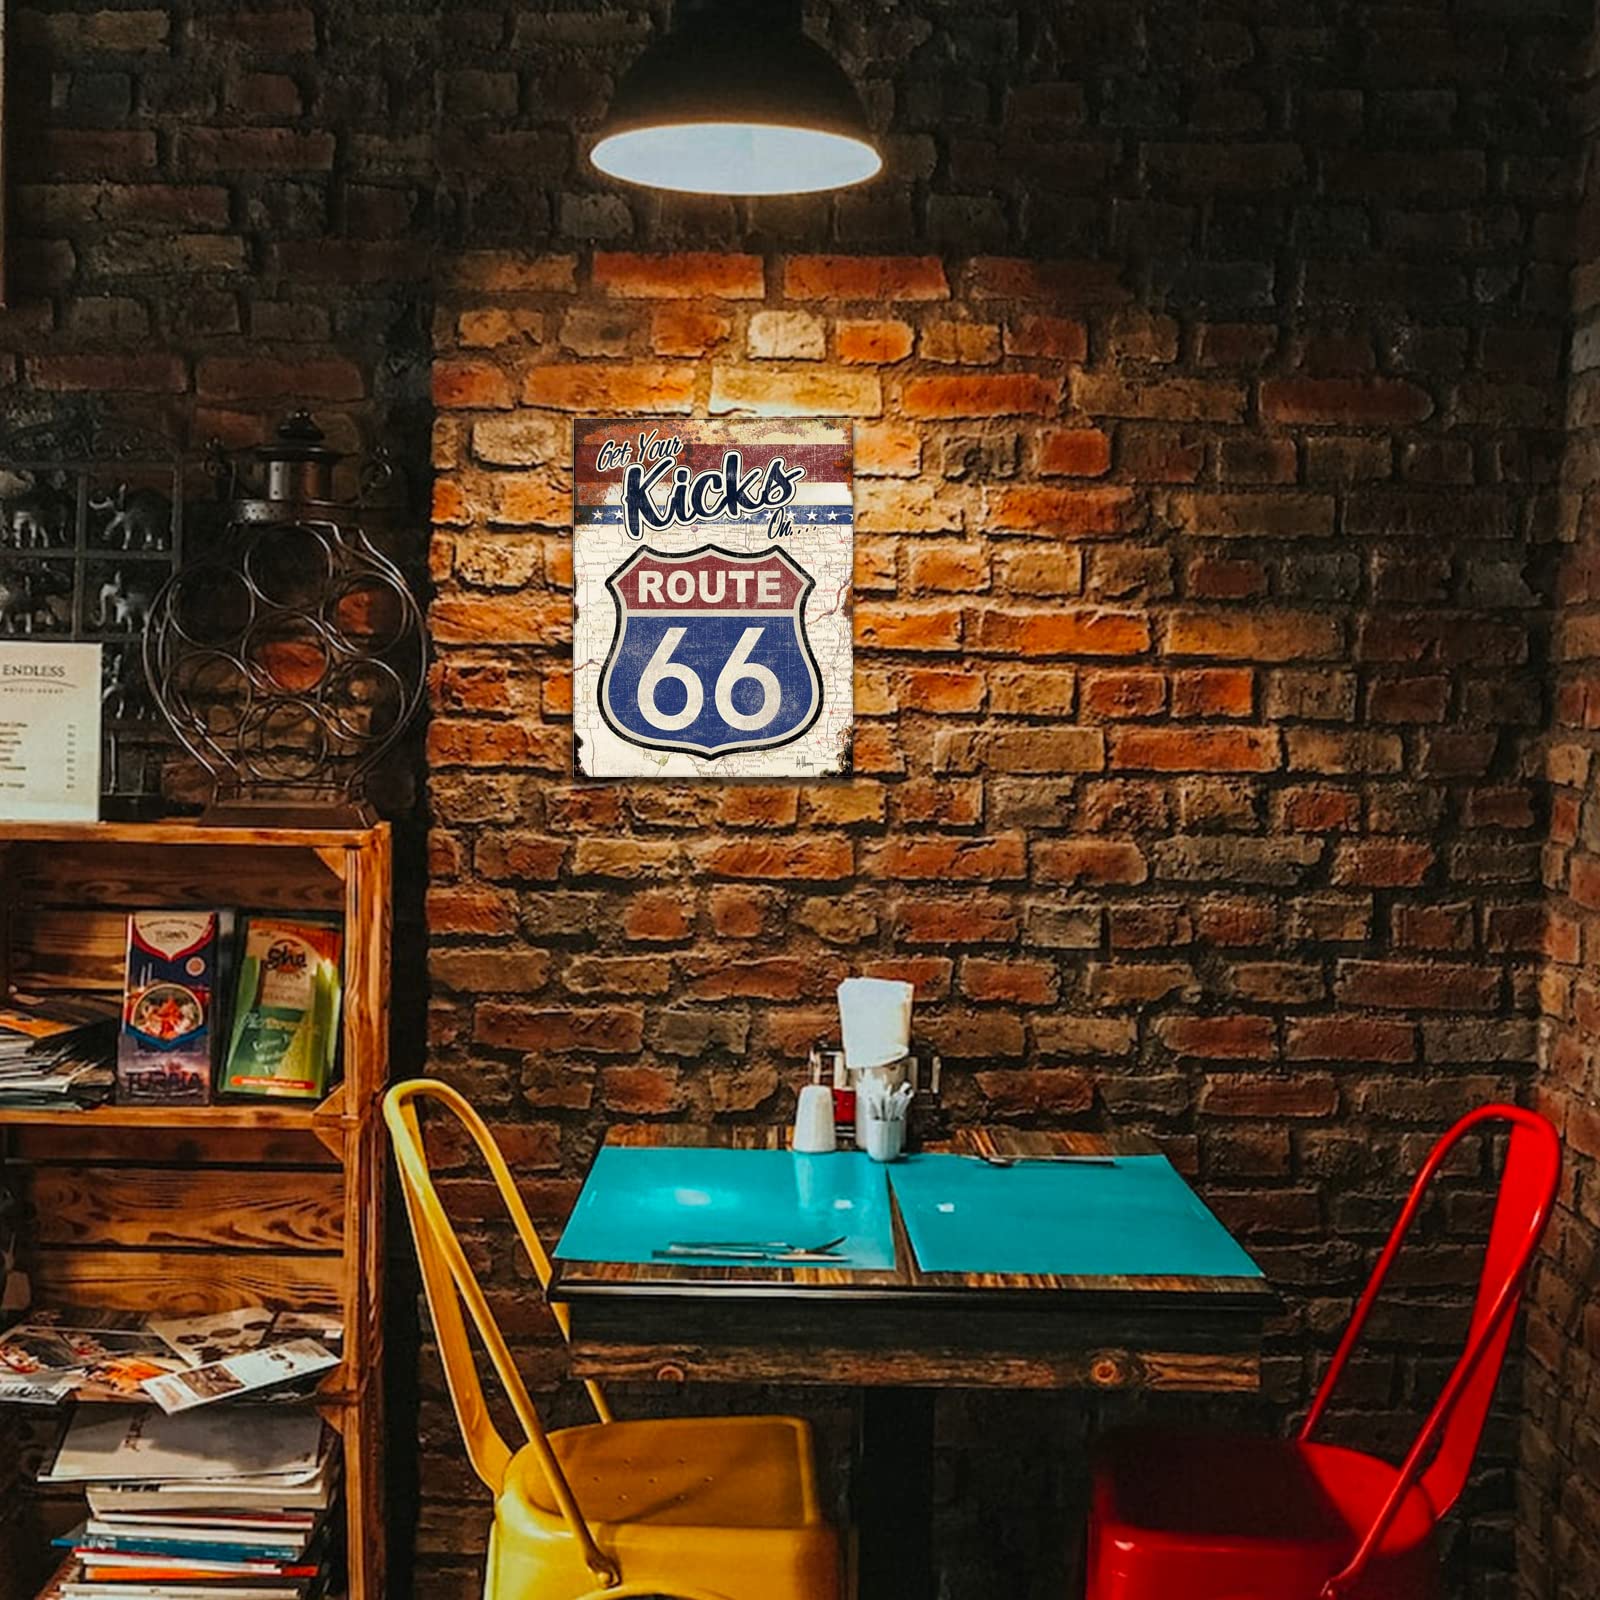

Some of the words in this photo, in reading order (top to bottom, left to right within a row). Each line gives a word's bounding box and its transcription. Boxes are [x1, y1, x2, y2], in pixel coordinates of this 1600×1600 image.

[596, 440, 631, 471] Get
[637, 430, 683, 462] Your
[622, 451, 806, 540] Kicks
[637, 569, 782, 604] ROUTE
[2, 663, 66, 678] ENDLESS
[637, 626, 782, 731] 66
